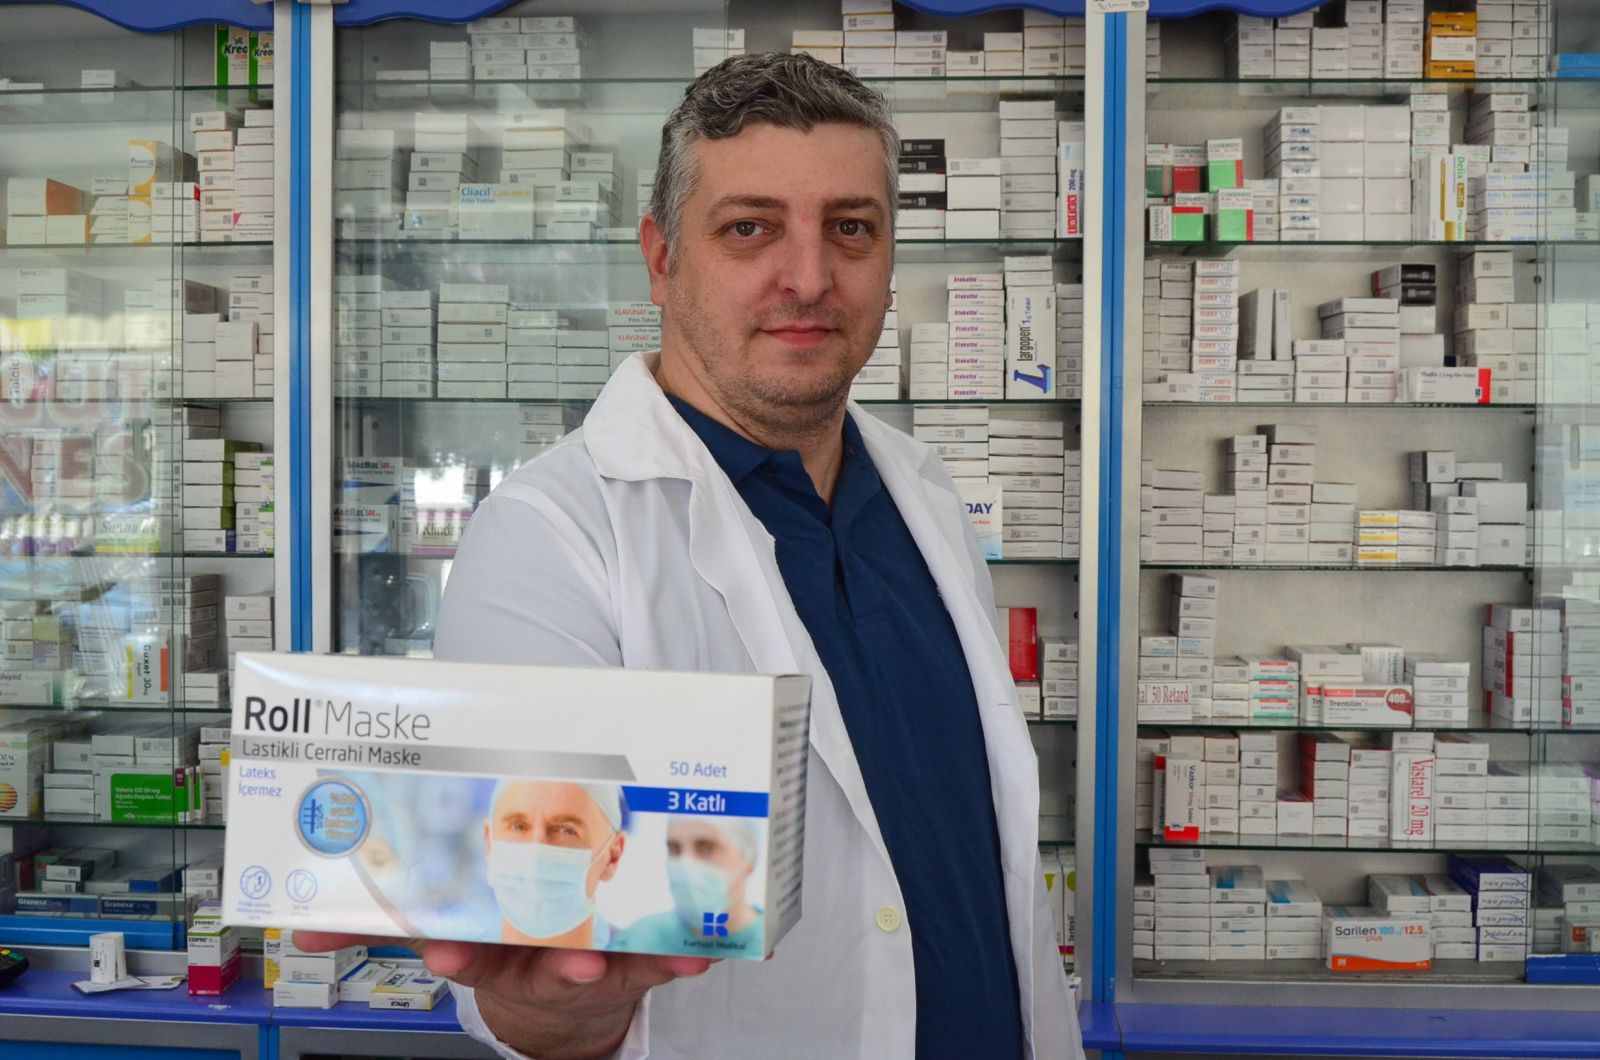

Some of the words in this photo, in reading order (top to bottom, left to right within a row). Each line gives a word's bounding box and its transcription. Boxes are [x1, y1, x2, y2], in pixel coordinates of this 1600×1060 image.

[1457, 157, 1466, 179] Delix
[461, 187, 490, 196] Cliacil
[1017, 326, 1034, 362] Largopen
[1152, 686, 1161, 703] 50
[1162, 684, 1189, 704] Retard
[244, 696, 311, 733] Roll
[325, 700, 430, 741] Maske
[242, 740, 299, 759] Lastikli
[304, 743, 362, 763] Cerrahi
[368, 746, 421, 766] Maske
[239, 766, 276, 779] Lateks
[670, 762, 689, 776] 50
[692, 762, 728, 778] Adet
[1188, 765, 1196, 790] Vazkor
[1411, 758, 1434, 800] Vastarel
[238, 782, 282, 798] İçermez
[668, 791, 680, 810] 3
[685, 792, 726, 812] Katlı
[1411, 805, 1429, 817] 20
[1403, 820, 1424, 836] mg
[18, 898, 47, 906] Granexa
[1335, 926, 1377, 936] Sarilen
